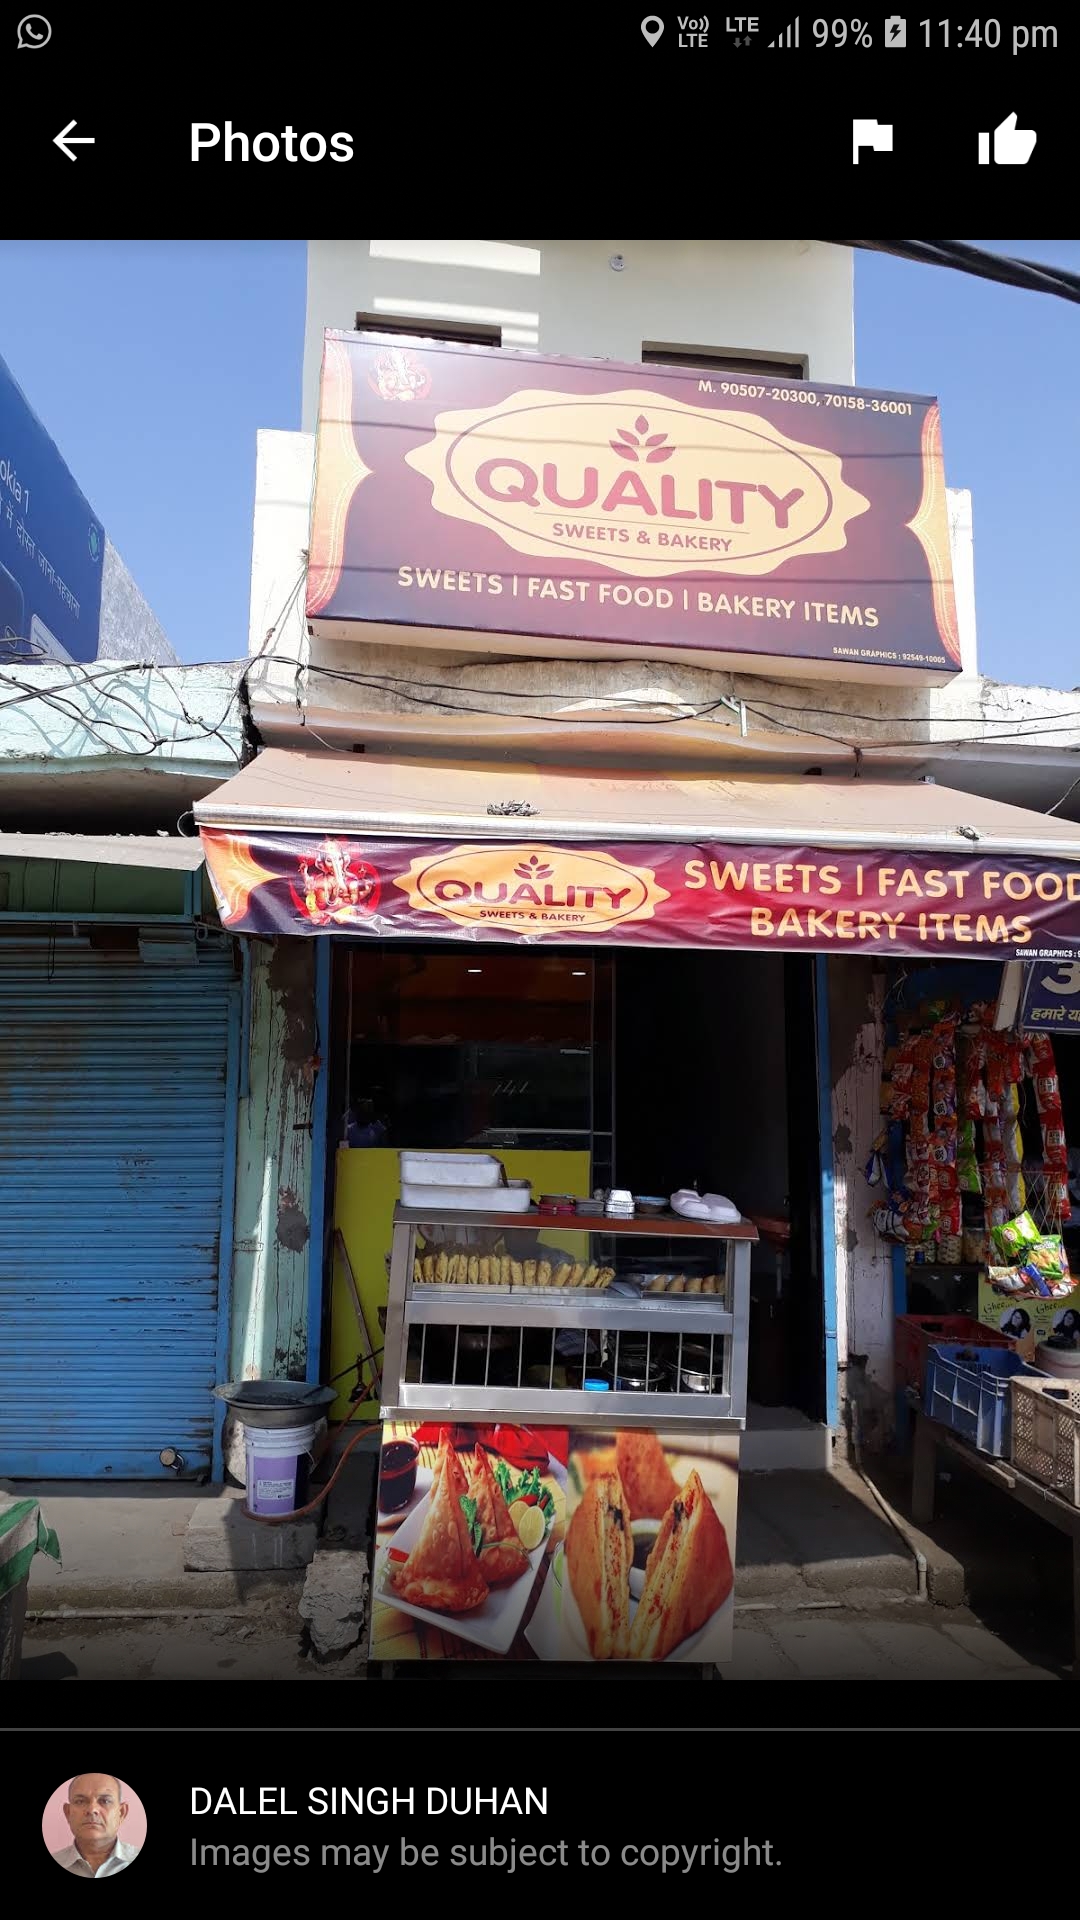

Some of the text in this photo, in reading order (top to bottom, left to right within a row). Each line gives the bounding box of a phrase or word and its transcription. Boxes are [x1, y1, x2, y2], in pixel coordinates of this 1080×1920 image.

[698, 380, 912, 416] M. 90507-20300, 70158-36001
[0, 460, 22, 504] okia
[475, 458, 804, 529] QUALITY
[552, 522, 732, 552] SWEETS & BAKERY
[398, 565, 503, 595] SWEETS
[527, 577, 590, 602] FAST
[599, 584, 673, 609] FOOD
[698, 592, 795, 619] BAKERY
[804, 602, 879, 627] ITEMS
[832, 647, 859, 656] SAWAN
[860, 649, 897, 659] GRAPHICS
[434, 879, 632, 910] QUALITY
[684, 859, 841, 895] SWEETS
[878, 867, 970, 899] FAST
[479, 909, 586, 922] SWEETS & BAKERY
[750, 907, 1032, 944] BAKERY ITEMS
[1015, 948, 1038, 957] SAWAN
[1039, 949, 1073, 958] GRAPHICS
